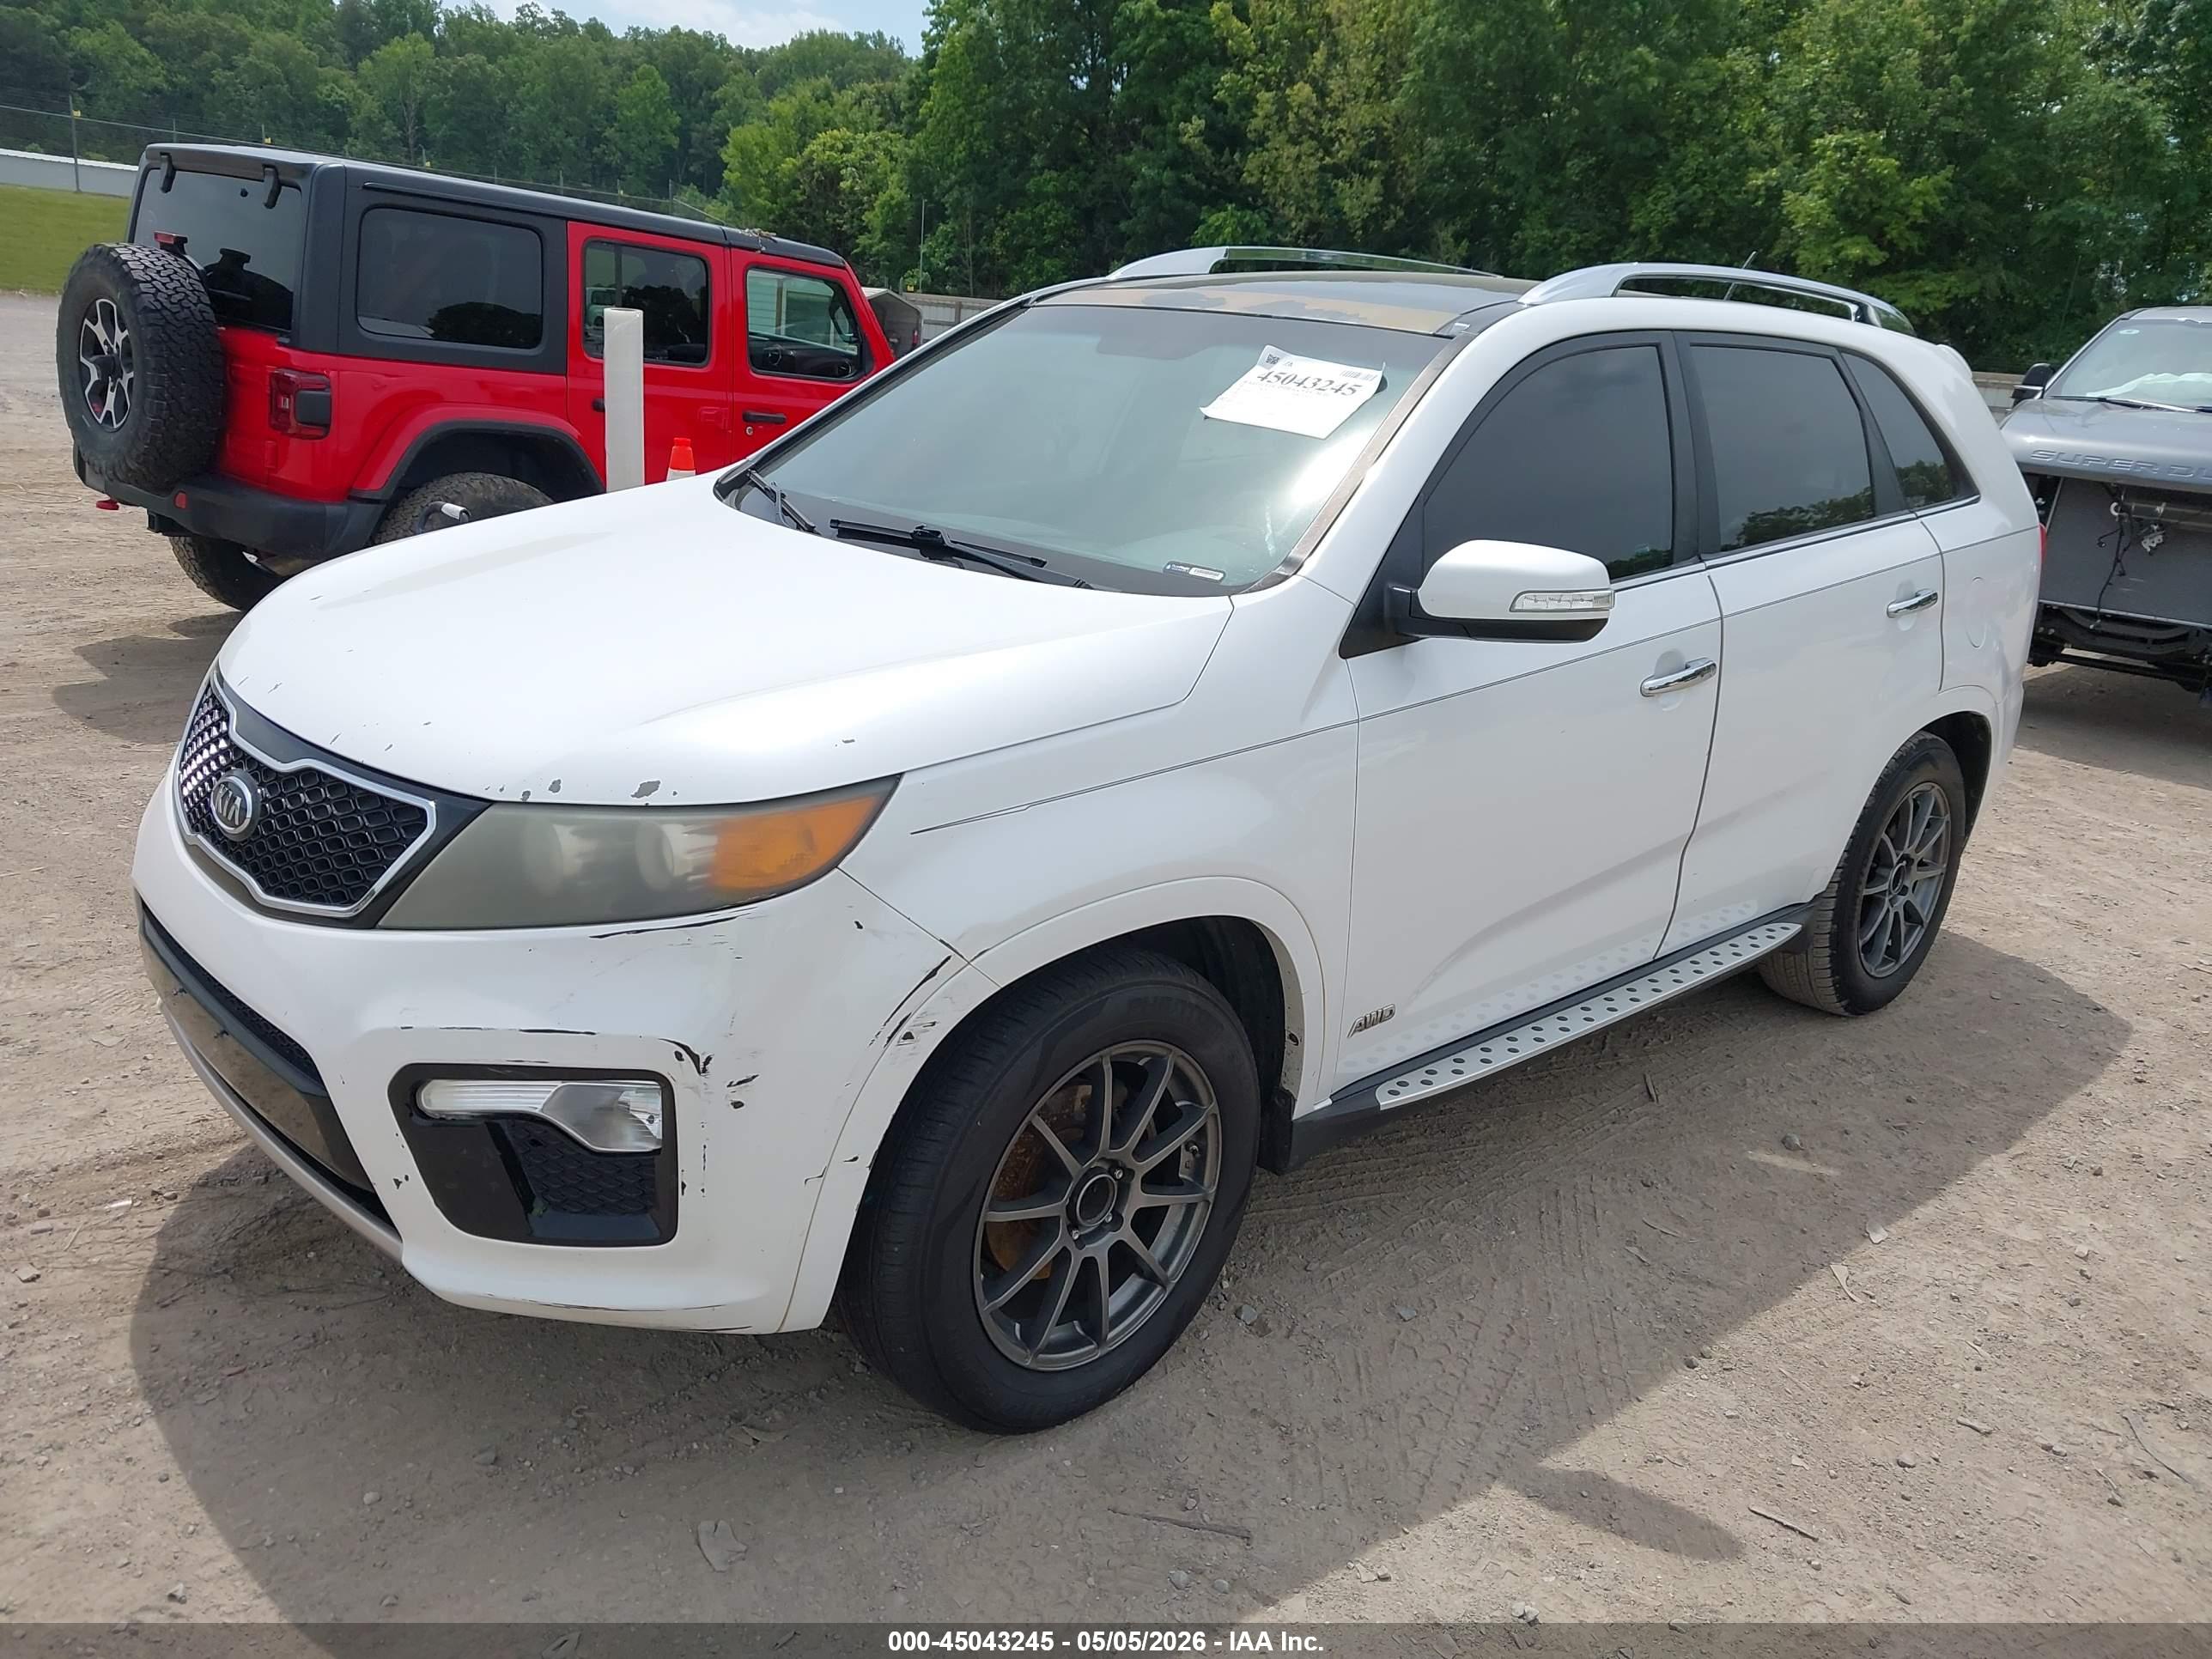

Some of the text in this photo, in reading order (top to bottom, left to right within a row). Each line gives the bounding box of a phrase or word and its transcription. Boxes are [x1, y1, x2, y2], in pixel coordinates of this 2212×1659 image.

[1257, 370, 1364, 396] 45043245
[2030, 449, 2159, 475] SUPER
[1346, 1003, 1396, 1038] AWD
